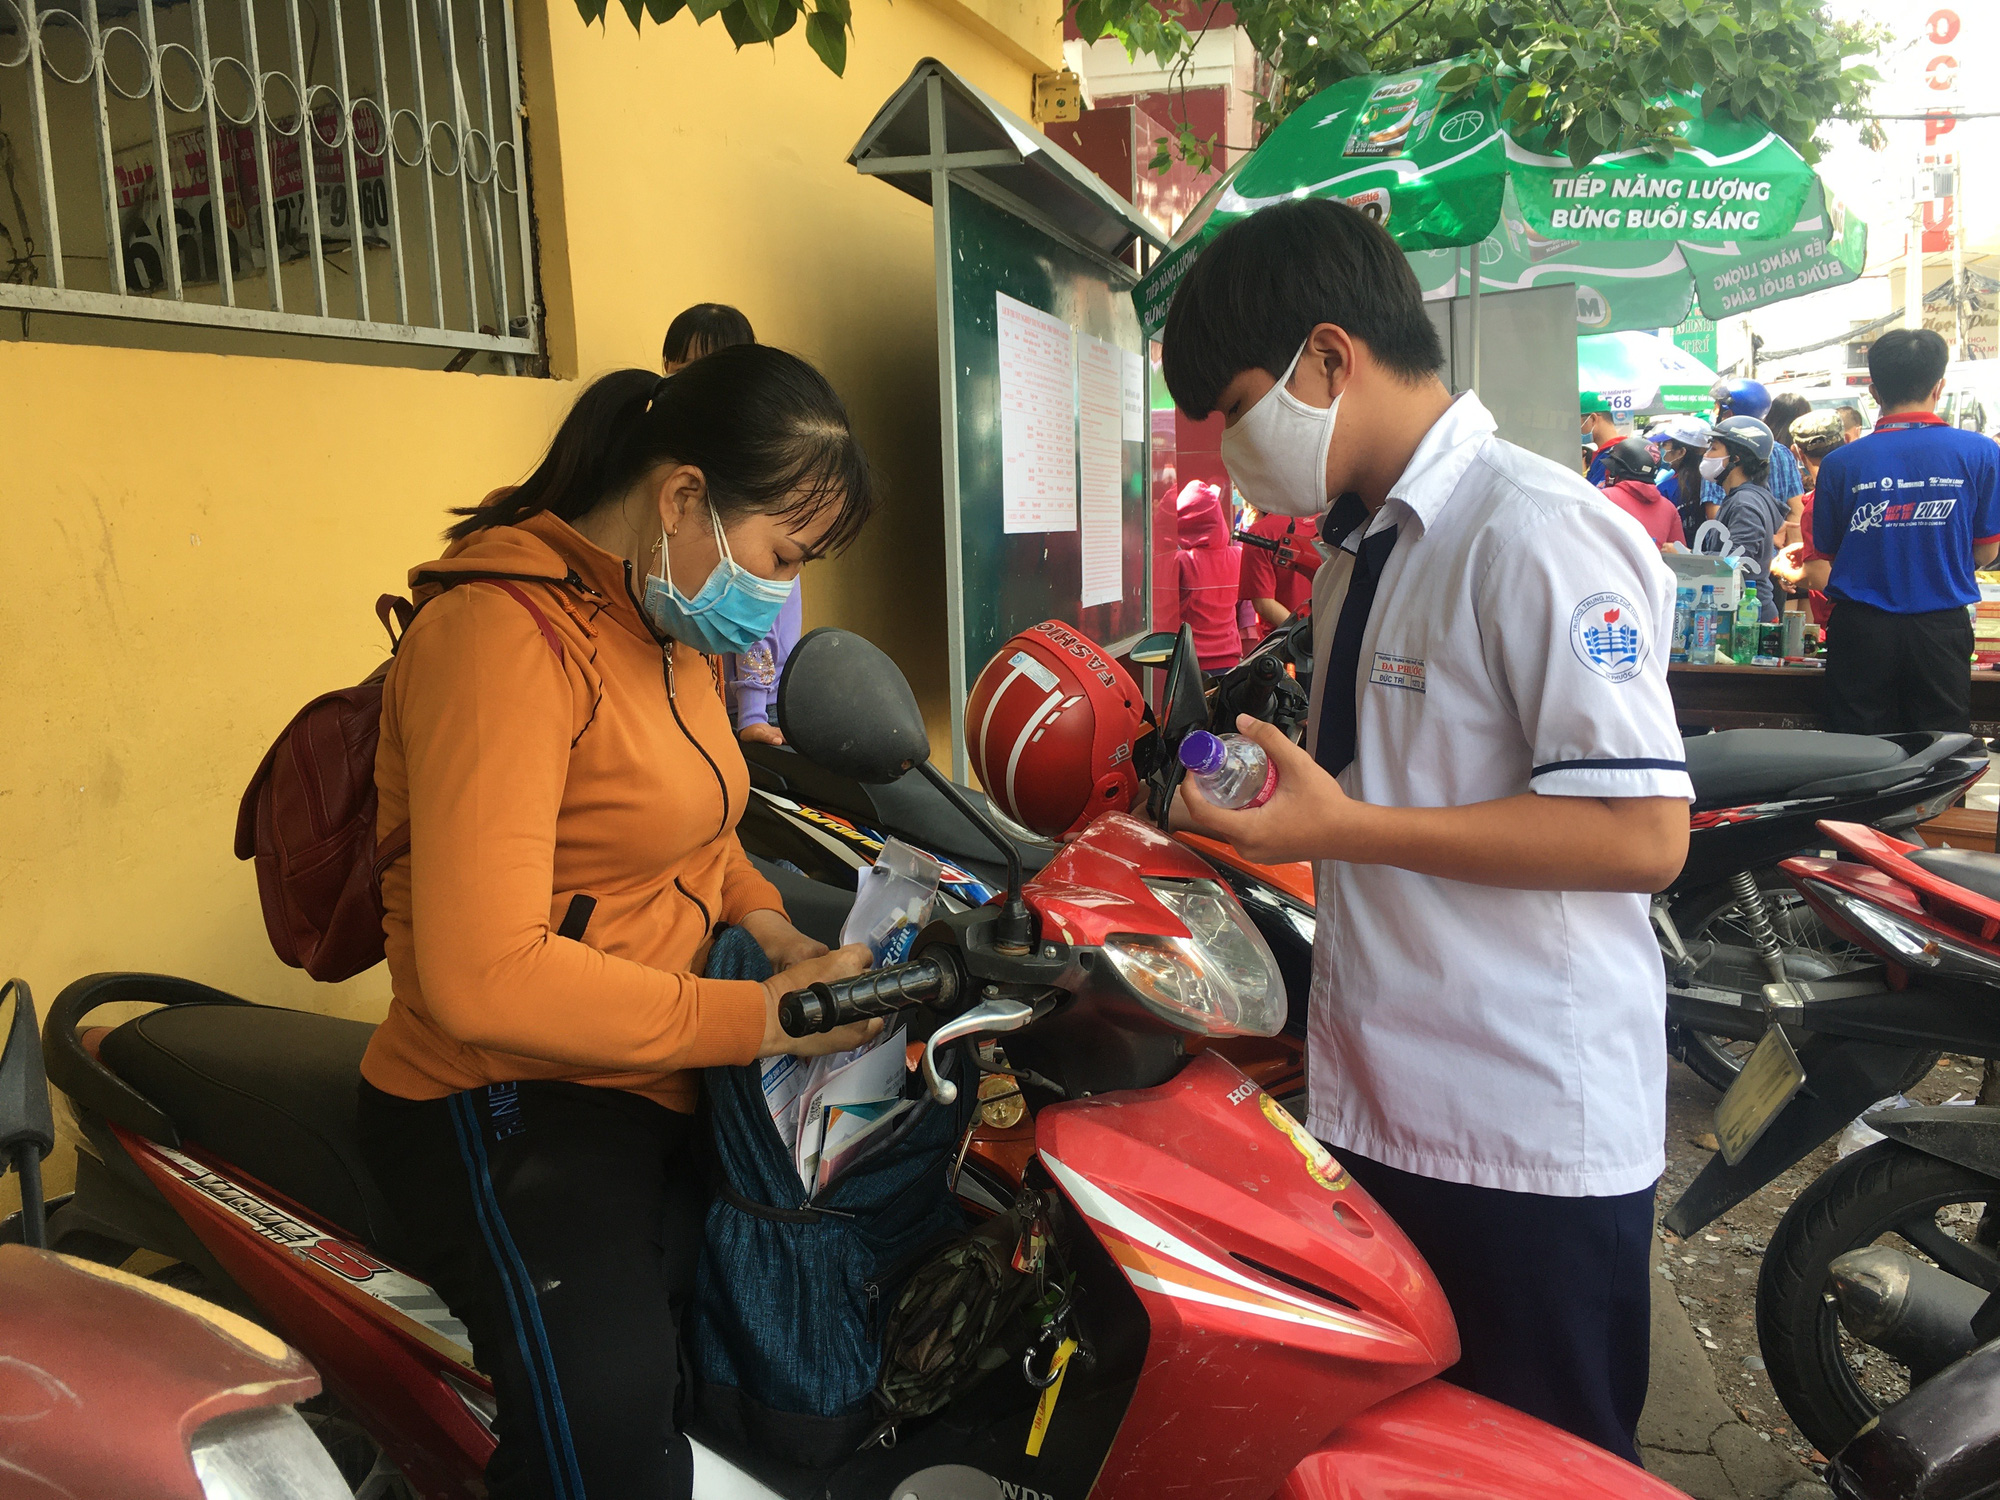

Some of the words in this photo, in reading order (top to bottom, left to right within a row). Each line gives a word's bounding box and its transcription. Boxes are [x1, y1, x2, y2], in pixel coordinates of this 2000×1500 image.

[1374, 84, 1417, 99] MILO
[1552, 171, 1607, 198] TIẾP
[1611, 173, 1683, 198] NĂNG
[1687, 176, 1771, 206] LƯỢNG
[1551, 204, 1621, 229] BỪNG
[1626, 201, 1687, 228] BUỔI
[1691, 205, 1760, 231] SÁNG
[1916, 501, 1952, 518] 2020
[798, 807, 885, 851] Wave
[192, 1173, 318, 1243] Wave
